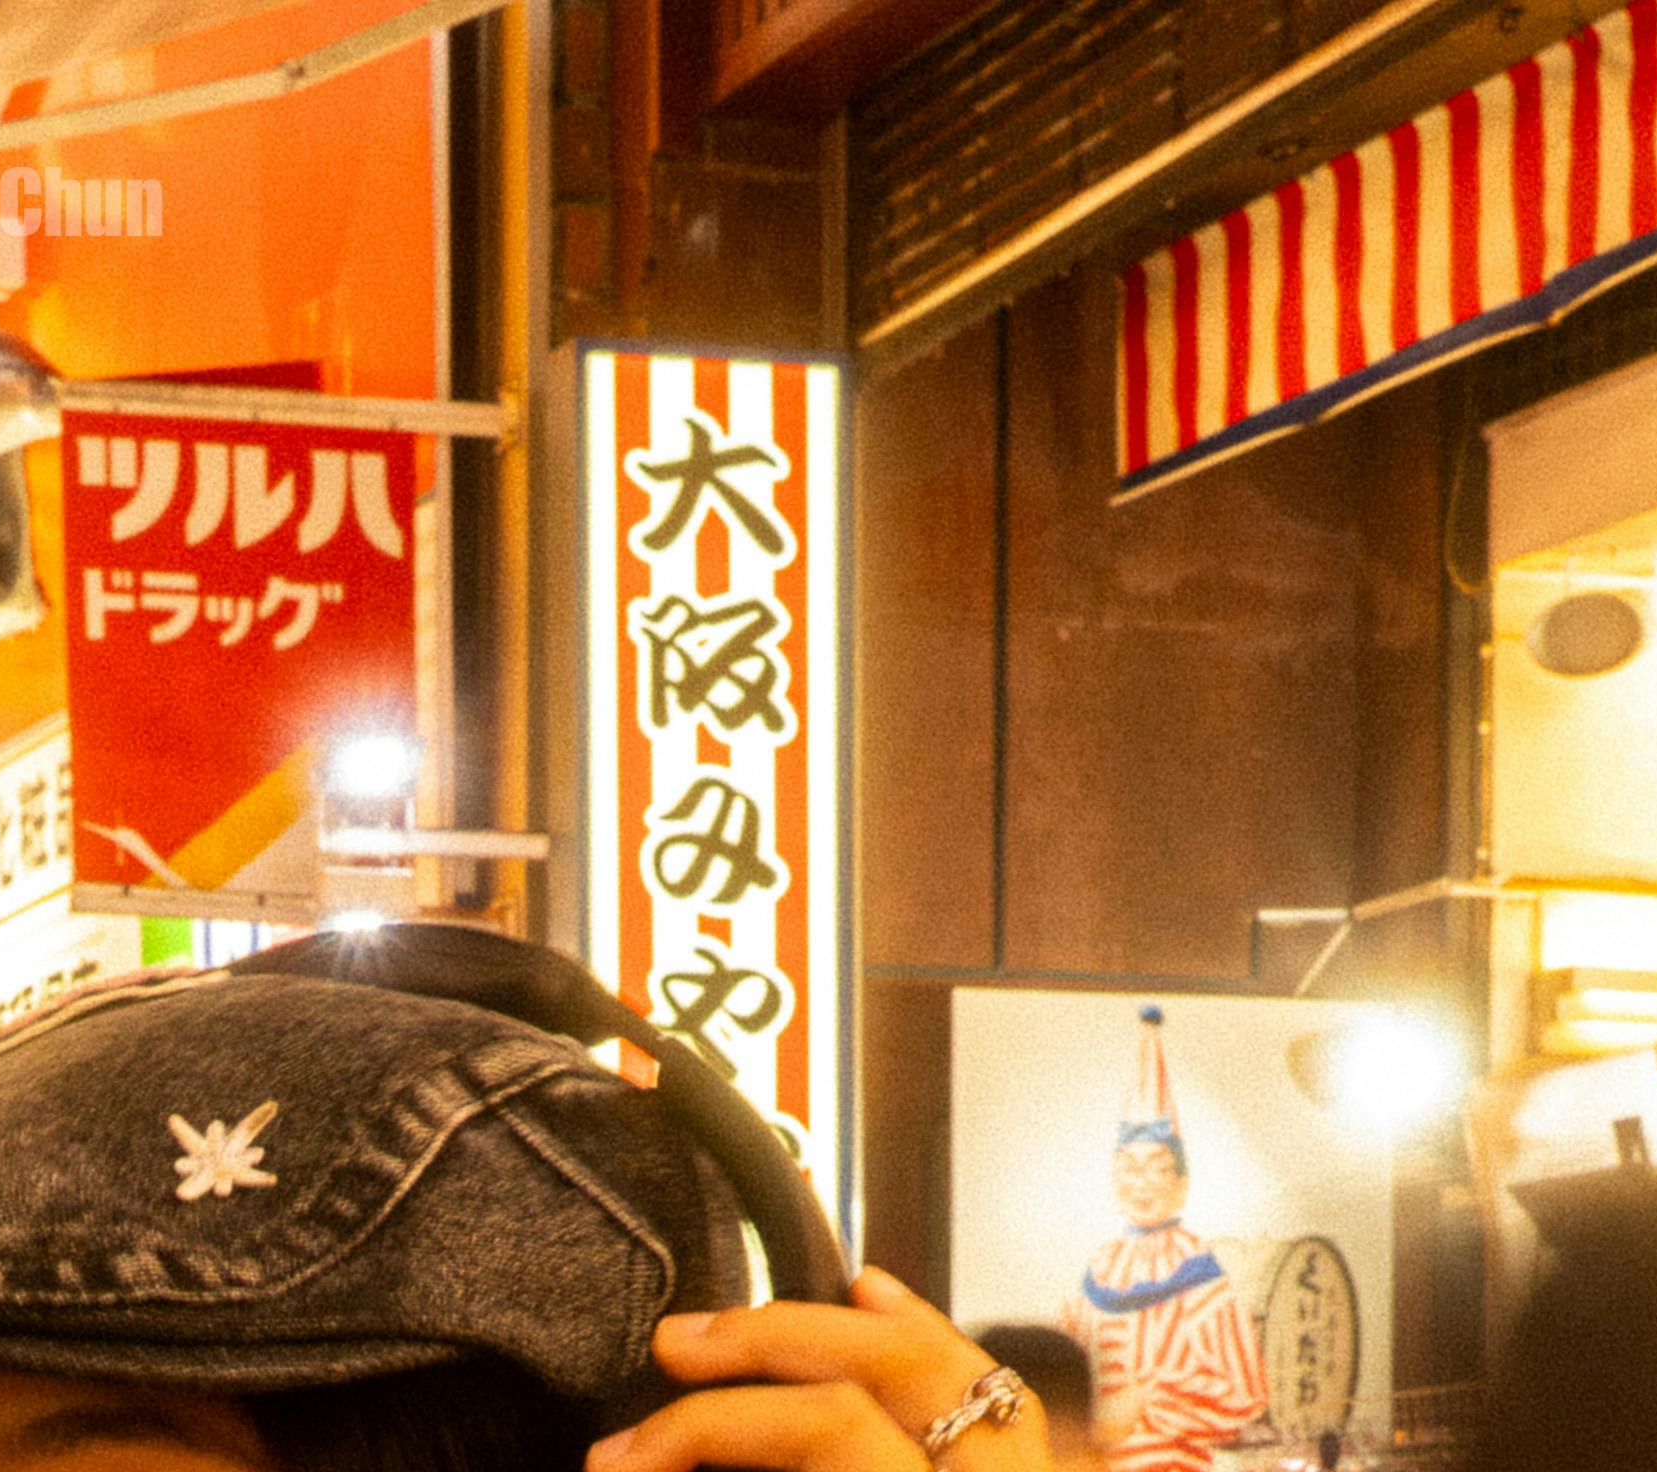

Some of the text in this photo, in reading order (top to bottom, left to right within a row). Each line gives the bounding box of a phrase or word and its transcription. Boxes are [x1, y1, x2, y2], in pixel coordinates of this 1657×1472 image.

[76, 434, 406, 560] ツルハ
[81, 566, 345, 653] ドラッグ
[634, 415, 804, 1162] 大阪みや
